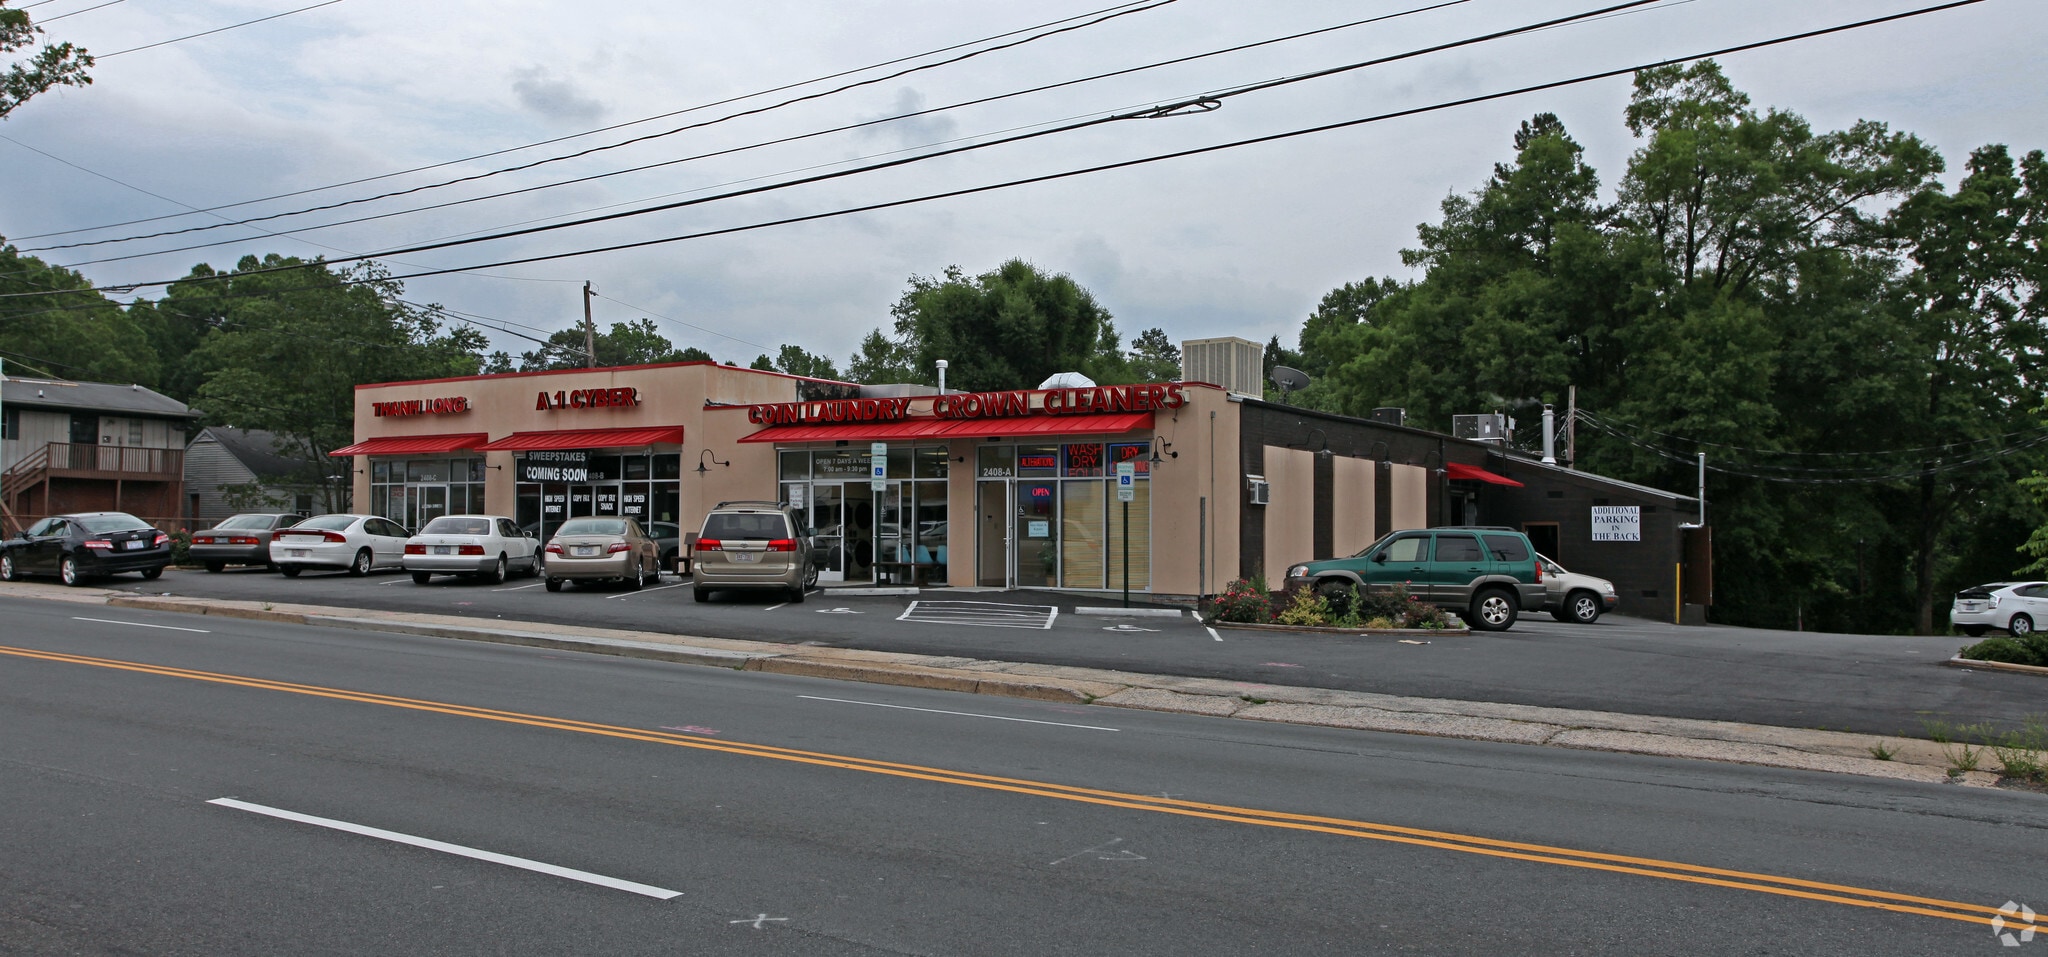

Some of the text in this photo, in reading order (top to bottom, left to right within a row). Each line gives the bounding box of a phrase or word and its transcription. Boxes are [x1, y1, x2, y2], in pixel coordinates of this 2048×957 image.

[536, 392, 551, 410] A
[570, 387, 637, 409] CYBER
[748, 383, 1185, 424] COIN LAUNDRY CROWN CLEANERS
[372, 396, 467, 417] THANH LONG
[1068, 444, 1103, 455] WASH
[1121, 446, 1139, 459] DRY
[529, 451, 586, 461] SWEEPSTAKES
[1021, 457, 1055, 467] ALTERATIONS
[1072, 456, 1098, 468] DRY
[526, 466, 588, 481] COMING SOON
[983, 467, 1012, 477] 2408-A
[1031, 487, 1051, 497] OPEN
[554, 495, 565, 503] SPEED
[573, 494, 581, 502] COPY
[598, 494, 607, 502] COPY
[624, 495, 645, 503] HIGH SPEED
[545, 505, 561, 513] INTERNET
[601, 503, 613, 511] SNACK
[625, 506, 641, 514] INTERNET
